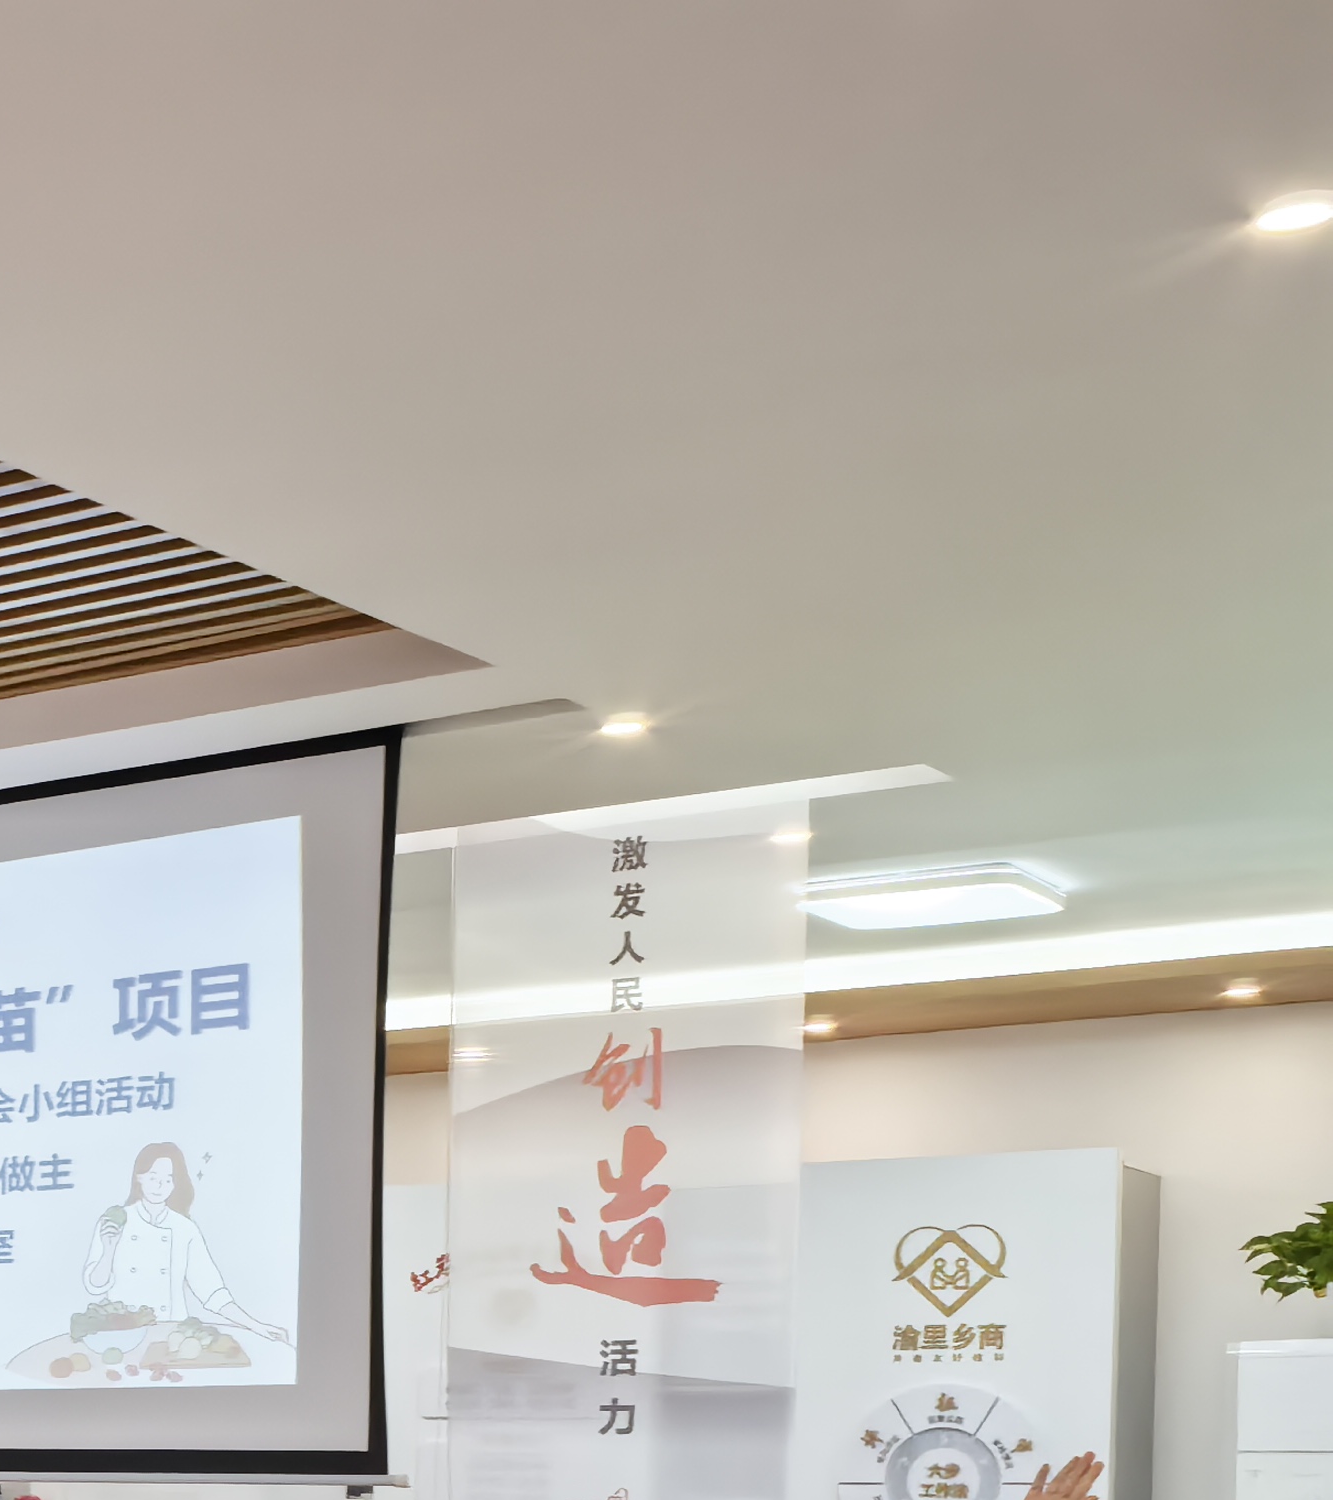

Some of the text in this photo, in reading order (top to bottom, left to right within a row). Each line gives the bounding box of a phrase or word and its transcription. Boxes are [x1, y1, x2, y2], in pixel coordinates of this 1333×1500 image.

[112, 962, 252, 1040] 项目
[530, 836, 722, 1436] 激发人民 创造 活力
